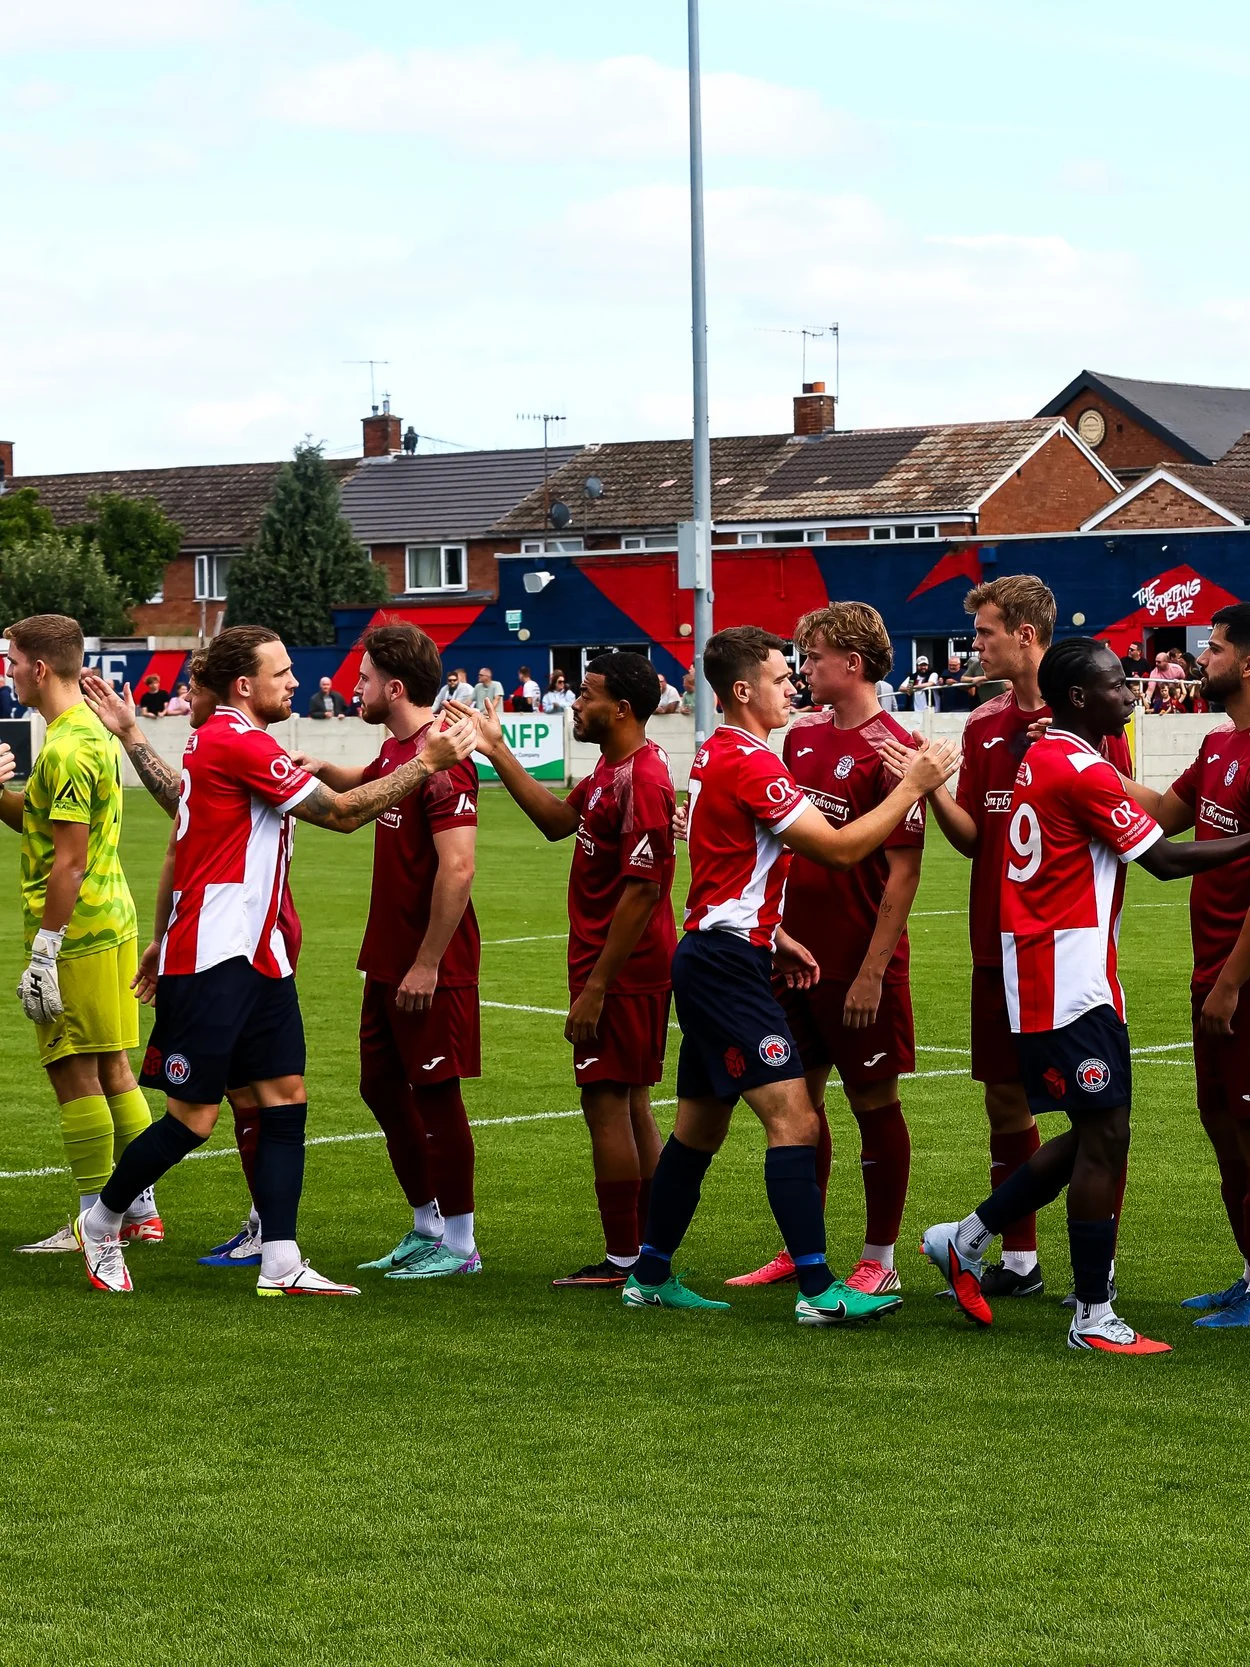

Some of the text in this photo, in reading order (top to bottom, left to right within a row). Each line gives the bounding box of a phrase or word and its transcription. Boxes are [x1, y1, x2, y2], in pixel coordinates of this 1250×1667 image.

[1132, 579, 1160, 606] THE
[1146, 578, 1201, 616] SPORTING
[1166, 600, 1194, 622] BAR
[1007, 803, 1042, 883] 9
